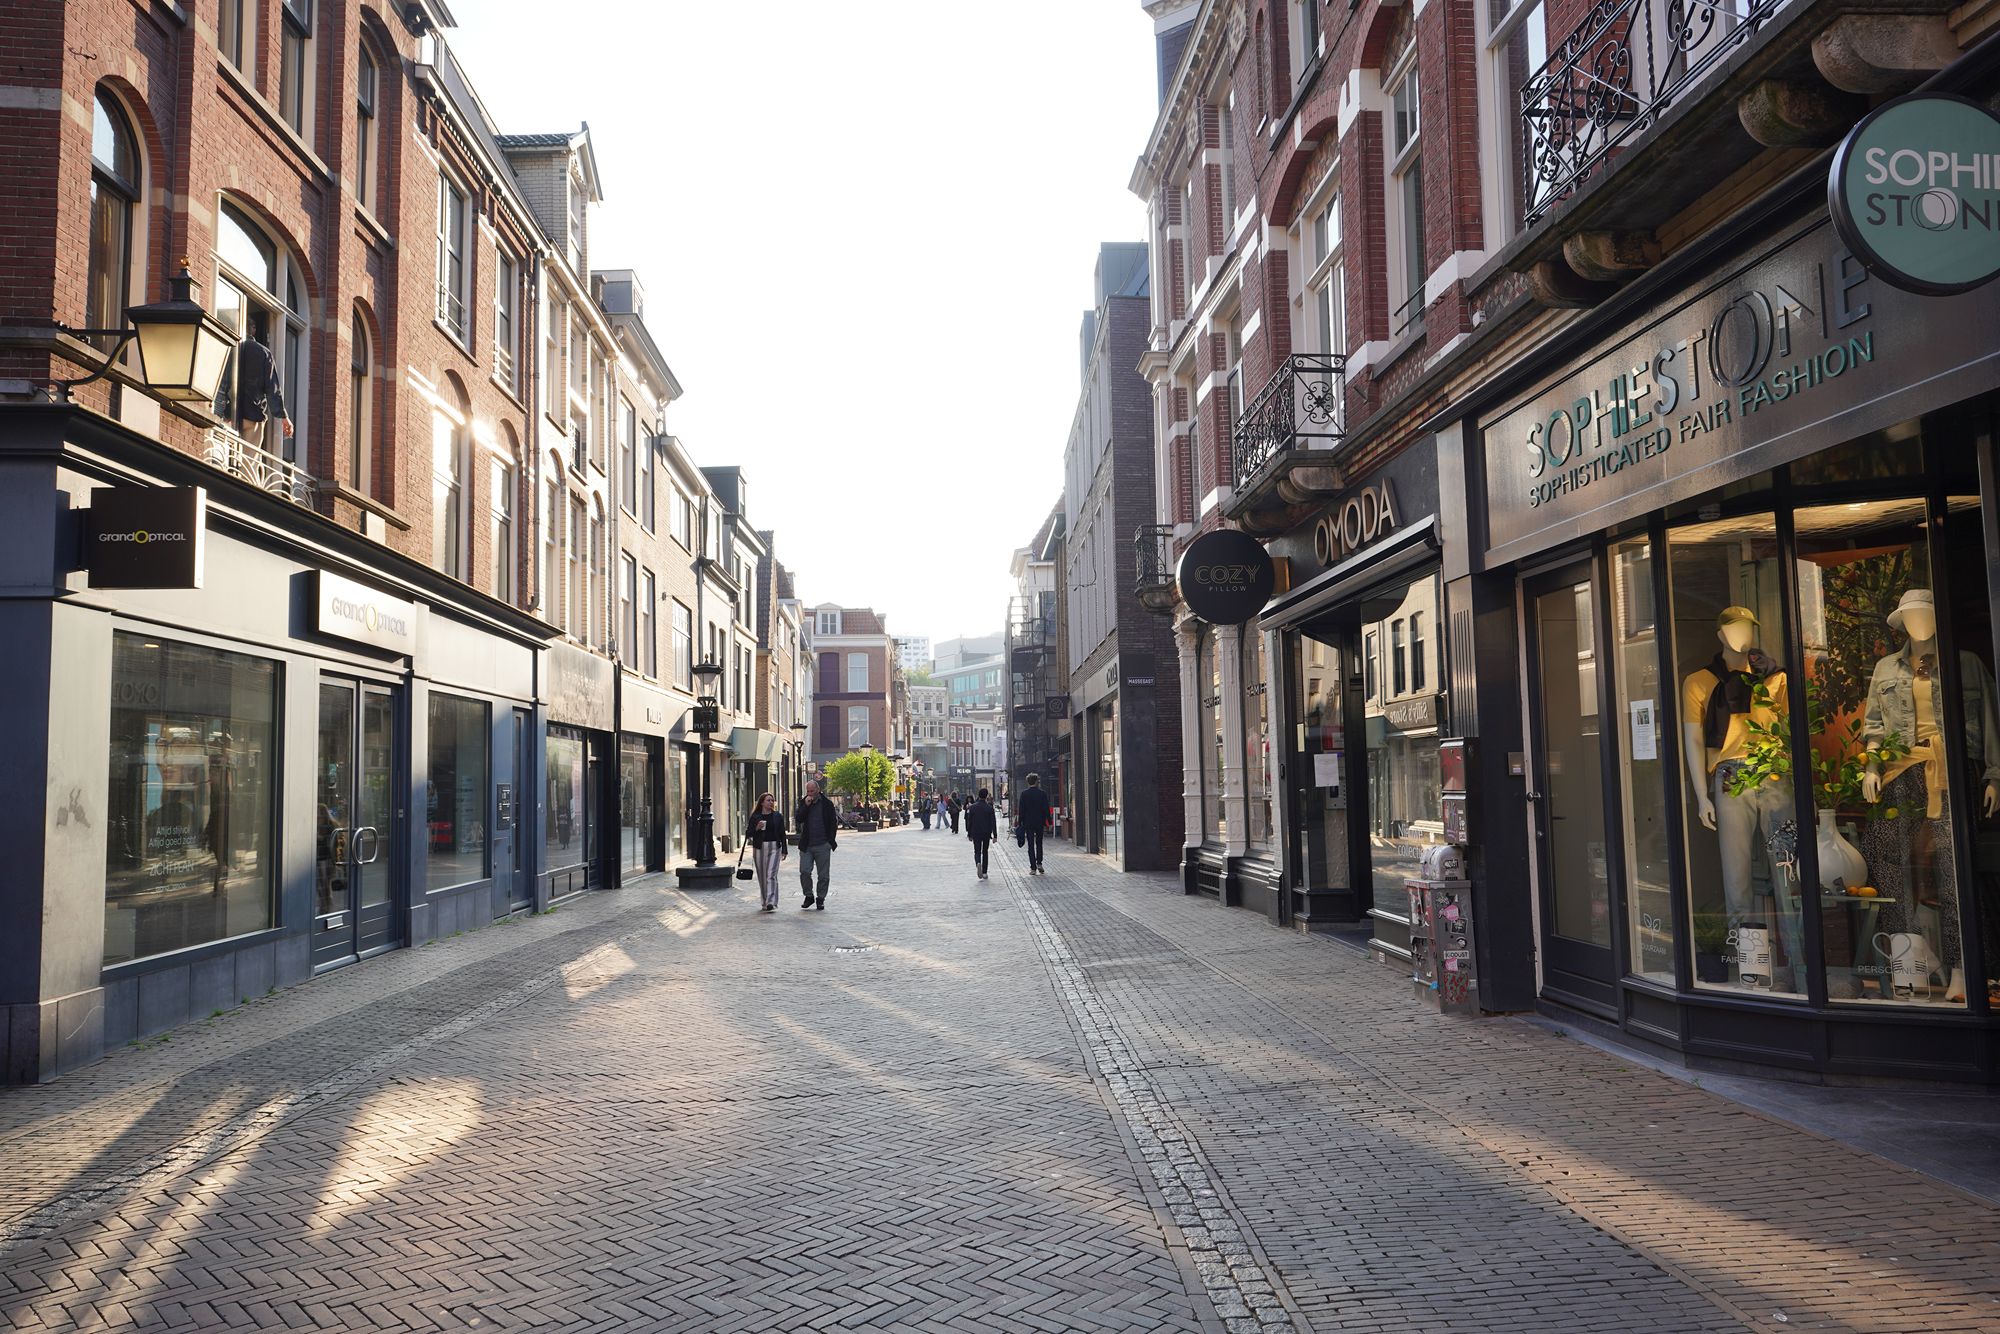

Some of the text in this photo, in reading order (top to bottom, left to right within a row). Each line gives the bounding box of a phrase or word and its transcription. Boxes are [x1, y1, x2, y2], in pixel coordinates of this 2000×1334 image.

[1866, 188, 2000, 231] STON
[1530, 330, 1874, 509] SOPHISTICATED FAIR FASHION
[1314, 477, 1402, 567] OMODA
[1194, 564, 1261, 585] COZY
[148, 837, 165, 848] Altijd
[165, 837, 182, 848] goed
[1721, 955, 1740, 964] FAIR
